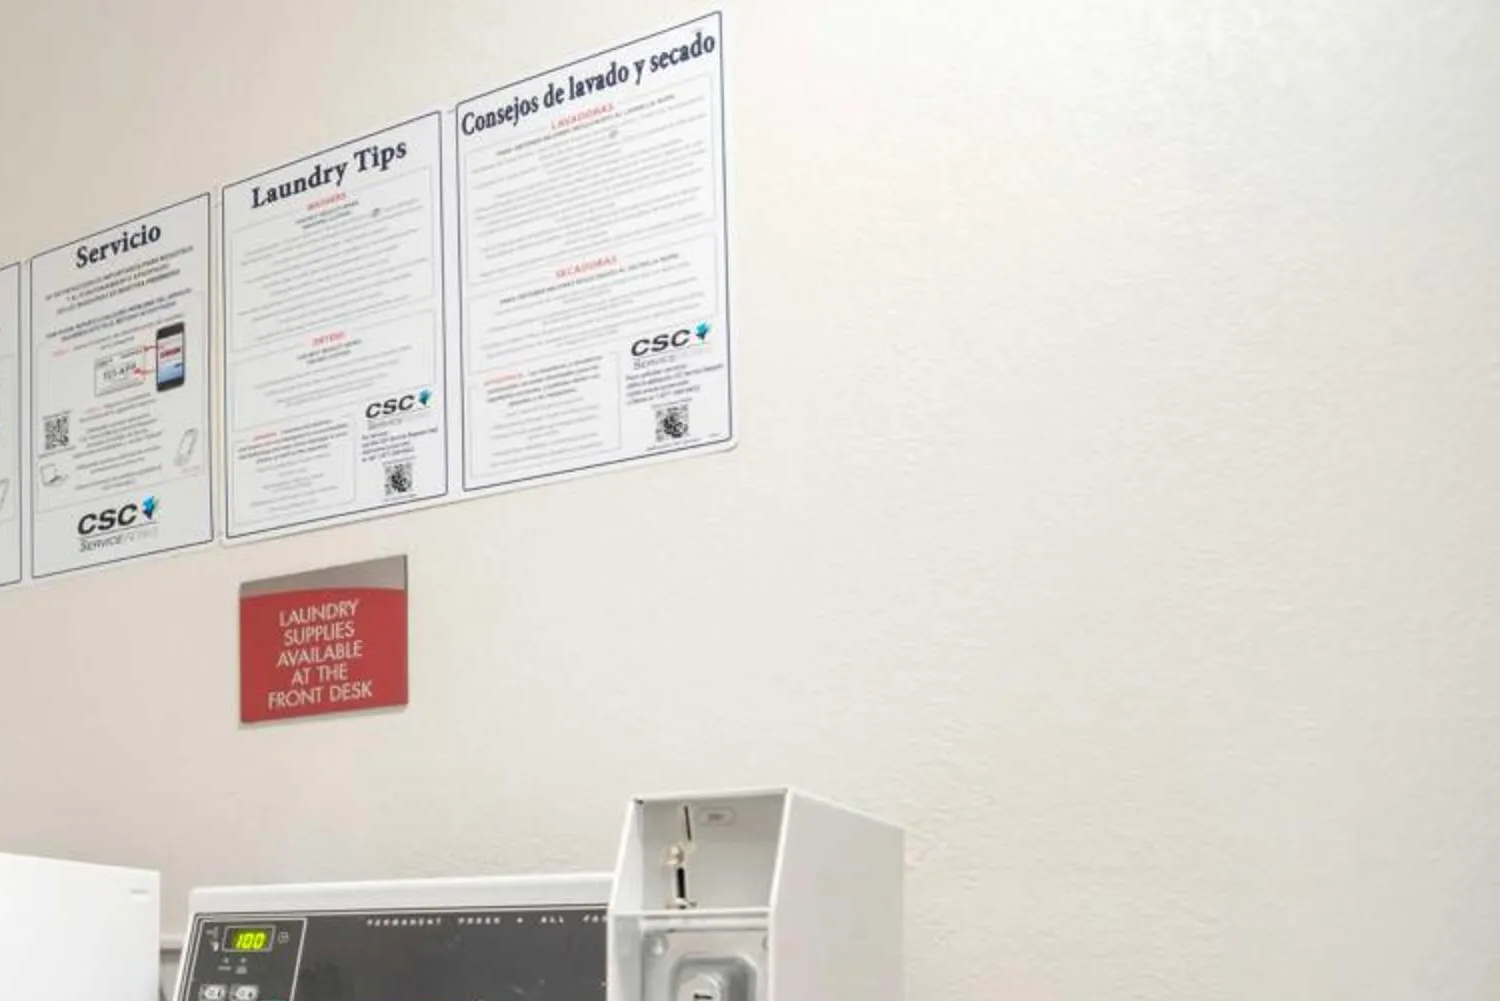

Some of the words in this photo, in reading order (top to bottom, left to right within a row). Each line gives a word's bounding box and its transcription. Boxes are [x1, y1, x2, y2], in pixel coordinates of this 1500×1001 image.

[461, 94, 539, 136] Consejos
[543, 83, 565, 108] de
[569, 61, 629, 100] lavado
[634, 58, 646, 86] y
[650, 31, 715, 73] secado
[251, 162, 349, 209] Laundry
[354, 141, 408, 172] Tips
[76, 224, 162, 269] Servicio
[631, 329, 691, 357] CSC
[365, 394, 415, 419] CSC
[78, 503, 139, 535] CSC
[278, 598, 360, 627] LAUNDRY
[283, 620, 356, 647] SUPPLIES
[275, 639, 364, 668] AVAILABLE
[291, 667, 311, 687] AT
[316, 662, 348, 683] THE
[267, 686, 325, 711] FRONT
[329, 679, 374, 702] DESK
[234, 932, 267, 950] 100
